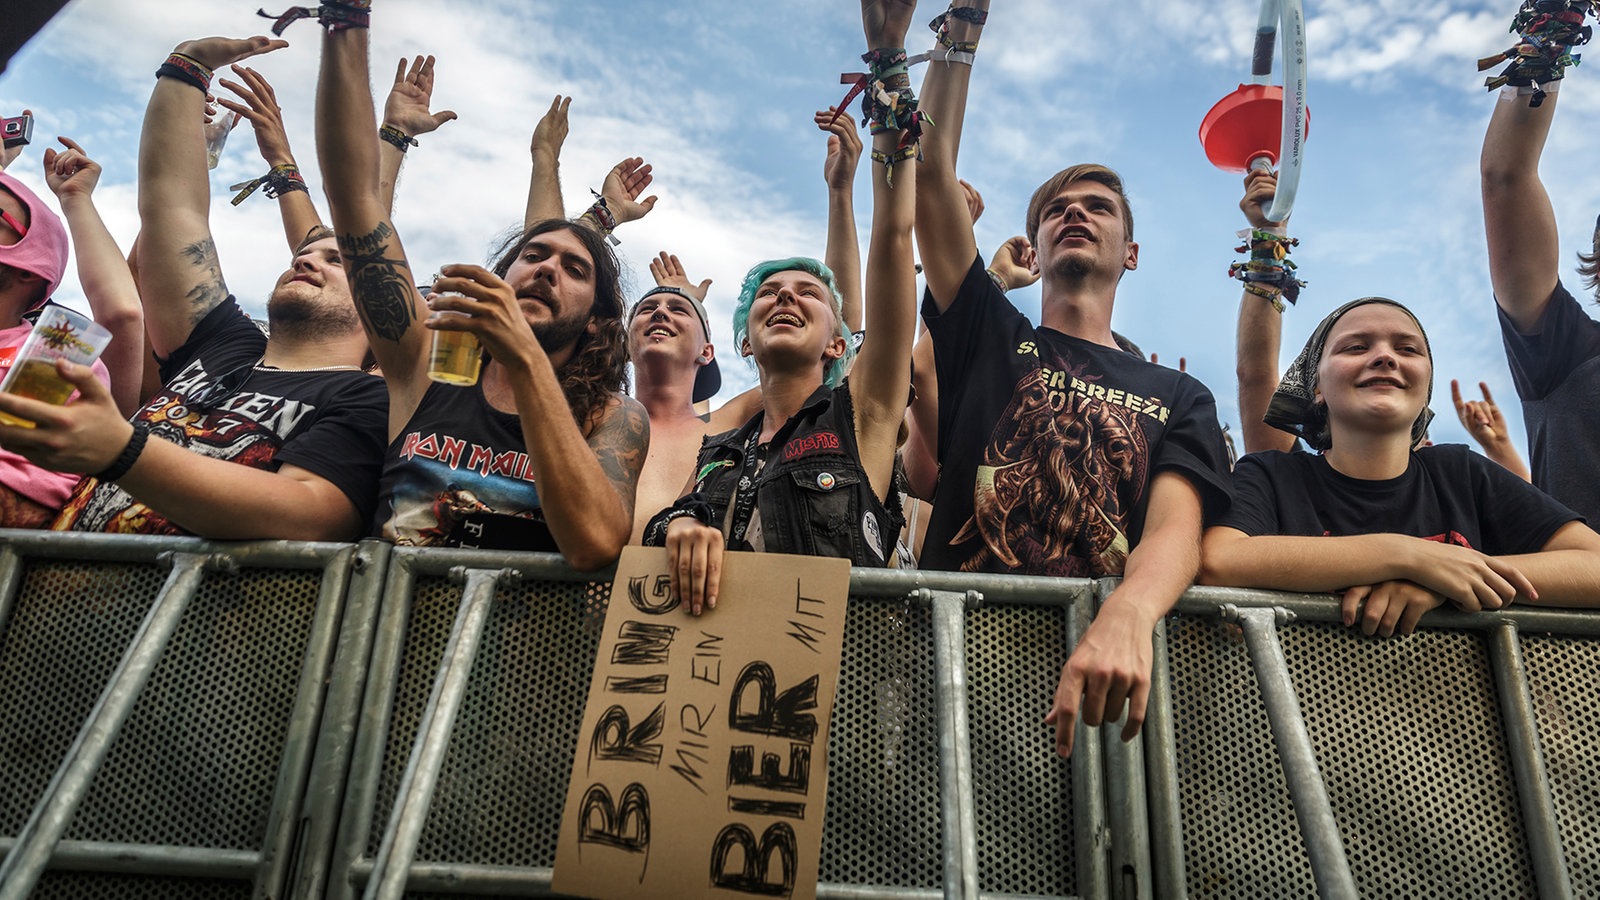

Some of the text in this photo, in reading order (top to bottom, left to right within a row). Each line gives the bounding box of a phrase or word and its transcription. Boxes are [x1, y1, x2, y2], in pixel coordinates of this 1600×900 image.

[1294, 114, 1302, 128] PVC
[1293, 128, 1301, 158] VARIOLUX
[146, 396, 243, 436] 2017
[1048, 390, 1092, 414] 017
[400, 432, 466, 470] IRON
[577, 574, 681, 884] BRING
[669, 630, 724, 796] MIR EIN
[709, 577, 826, 898] BIER MIT
